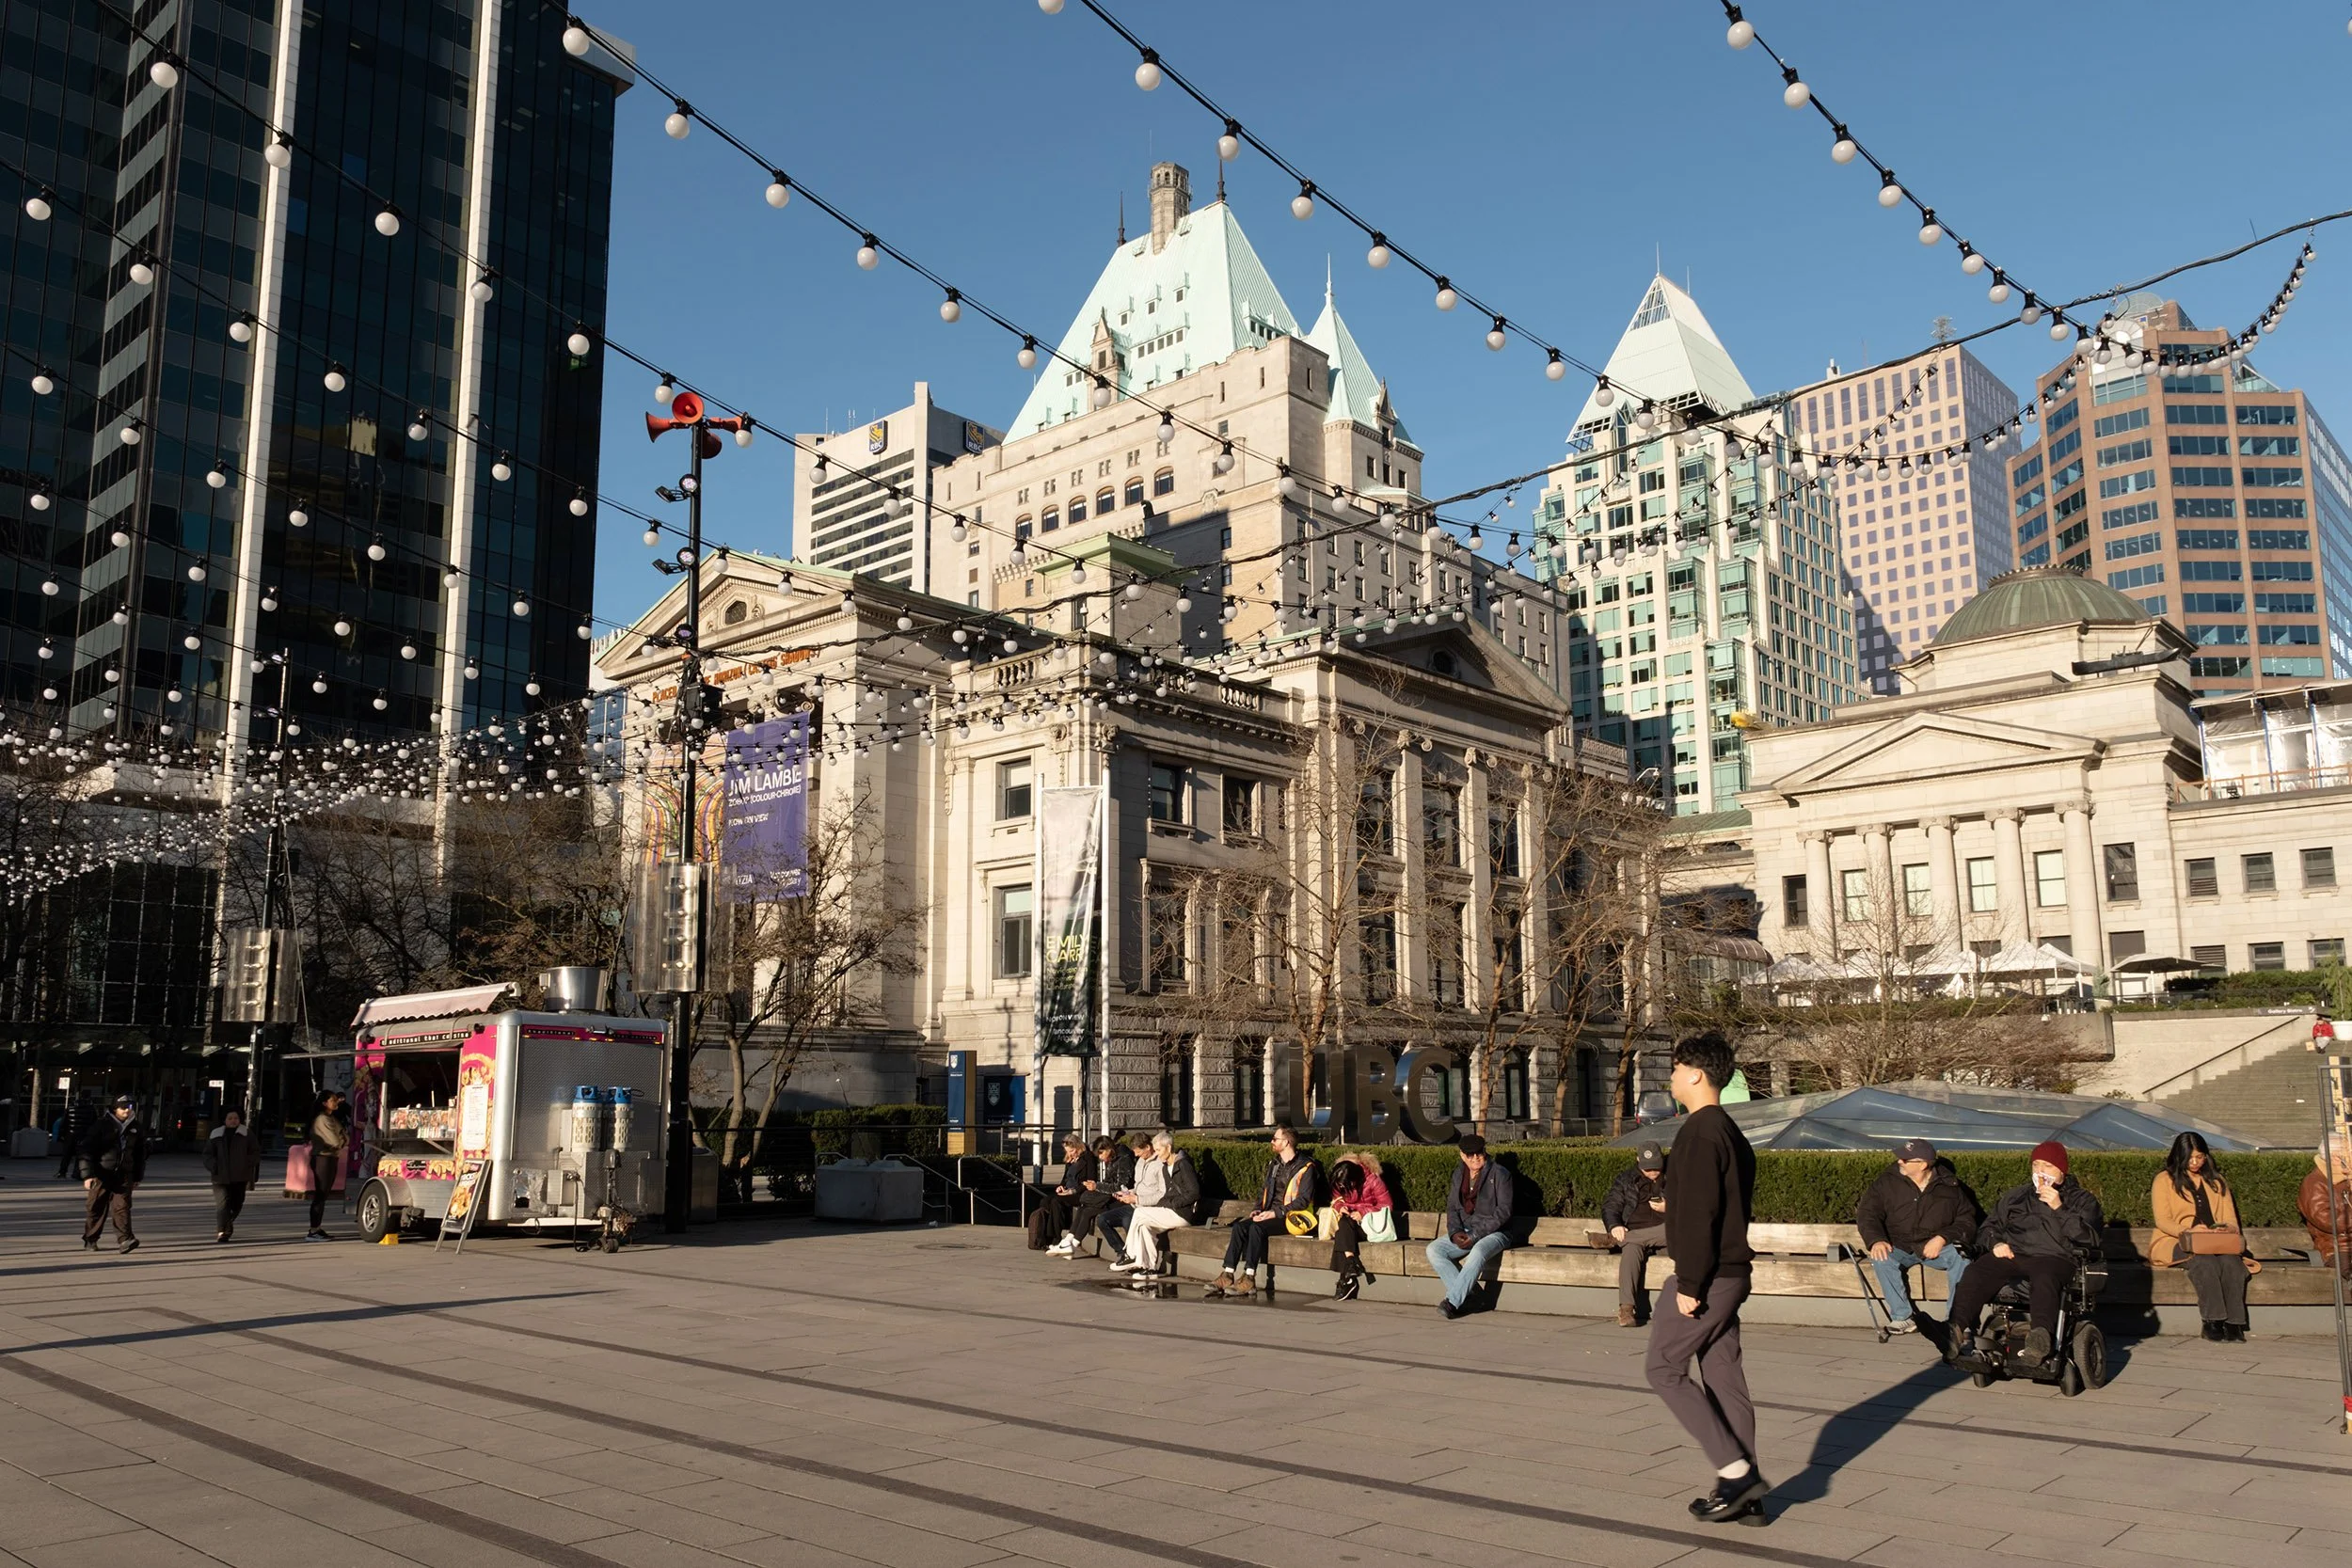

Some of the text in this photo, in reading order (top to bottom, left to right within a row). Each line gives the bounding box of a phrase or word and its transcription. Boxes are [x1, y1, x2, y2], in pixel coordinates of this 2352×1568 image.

[870, 442, 882, 451] RBC
[968, 442, 982, 451] RBC
[728, 768, 802, 797] JIM LAMBIE
[1046, 934, 1086, 950] EMILY
[1046, 949, 1083, 963] CARR
[424, 1035, 438, 1043] thai
[1274, 1041, 1460, 1144] UBC
